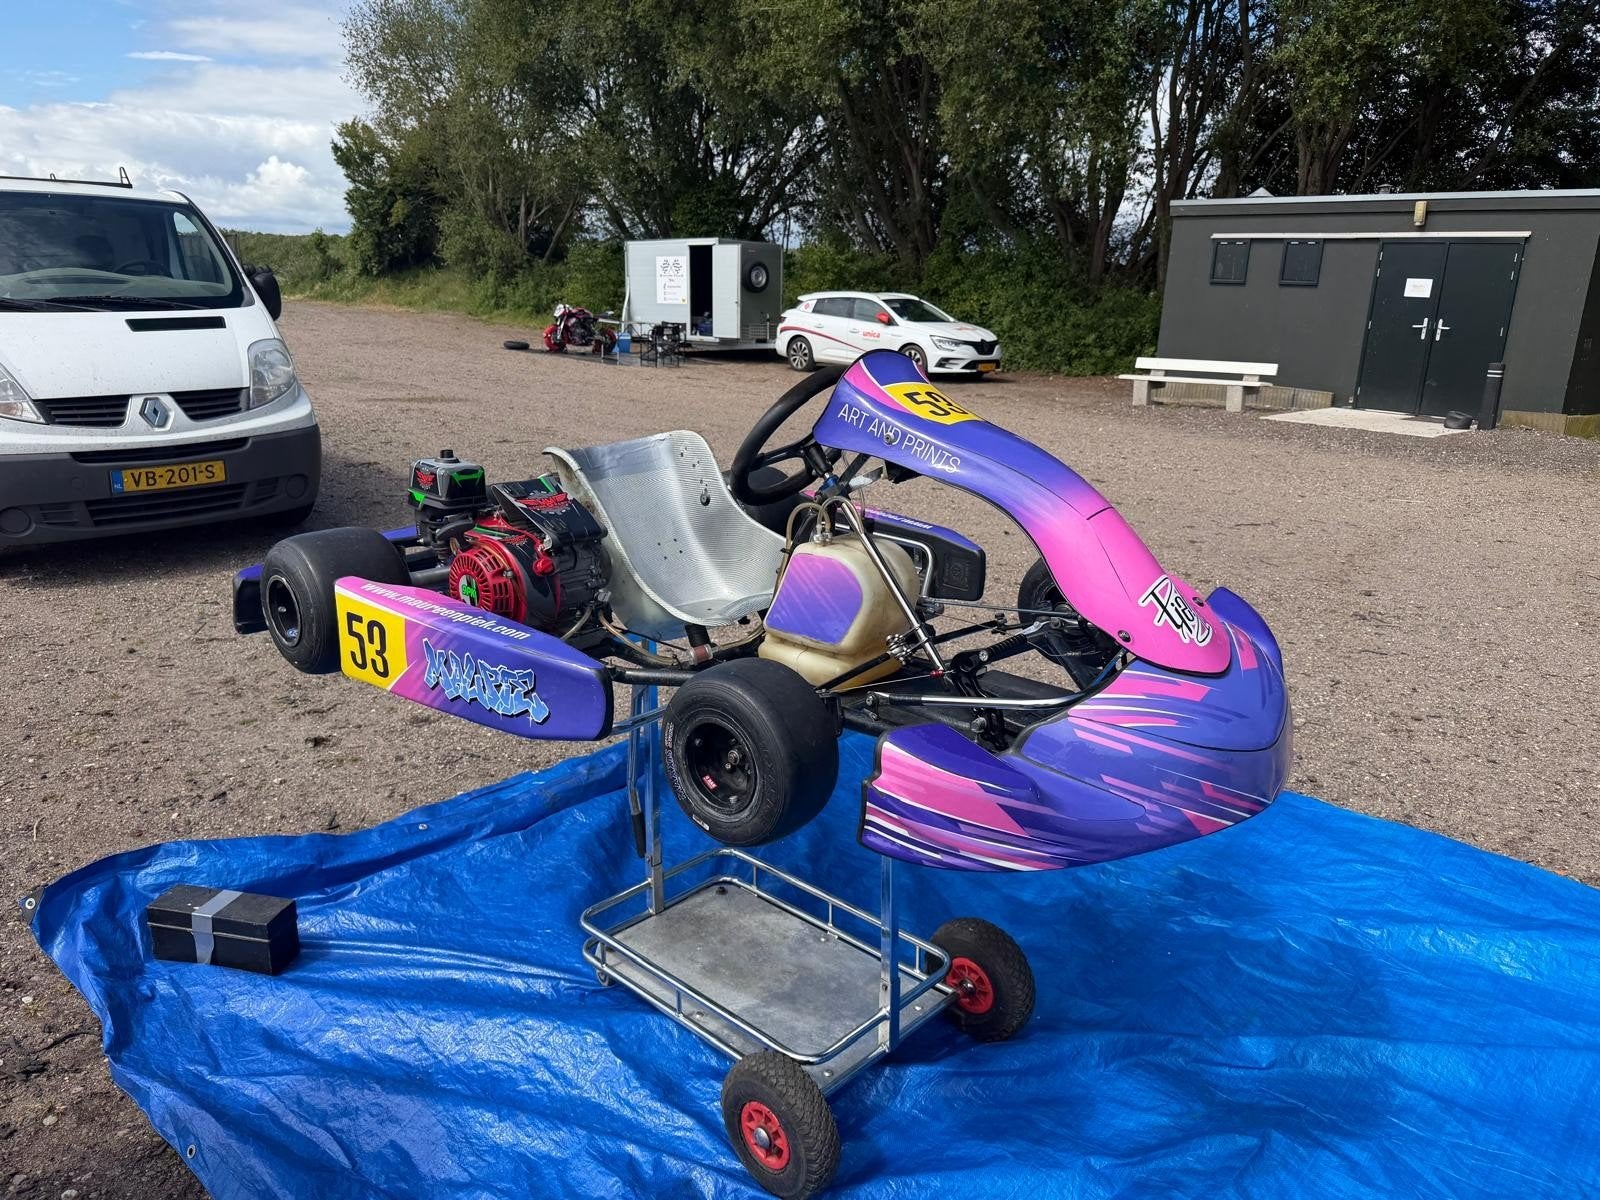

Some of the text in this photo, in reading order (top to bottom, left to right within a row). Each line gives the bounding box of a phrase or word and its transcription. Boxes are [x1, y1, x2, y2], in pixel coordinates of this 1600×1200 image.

[862, 329, 881, 339] unica
[903, 391, 969, 417] 53
[838, 403, 961, 473] ART AND PRINTS
[131, 464, 215, 488] VB-201-S
[361, 583, 533, 641] www.maureenpiek.com
[346, 611, 390, 679] 53
